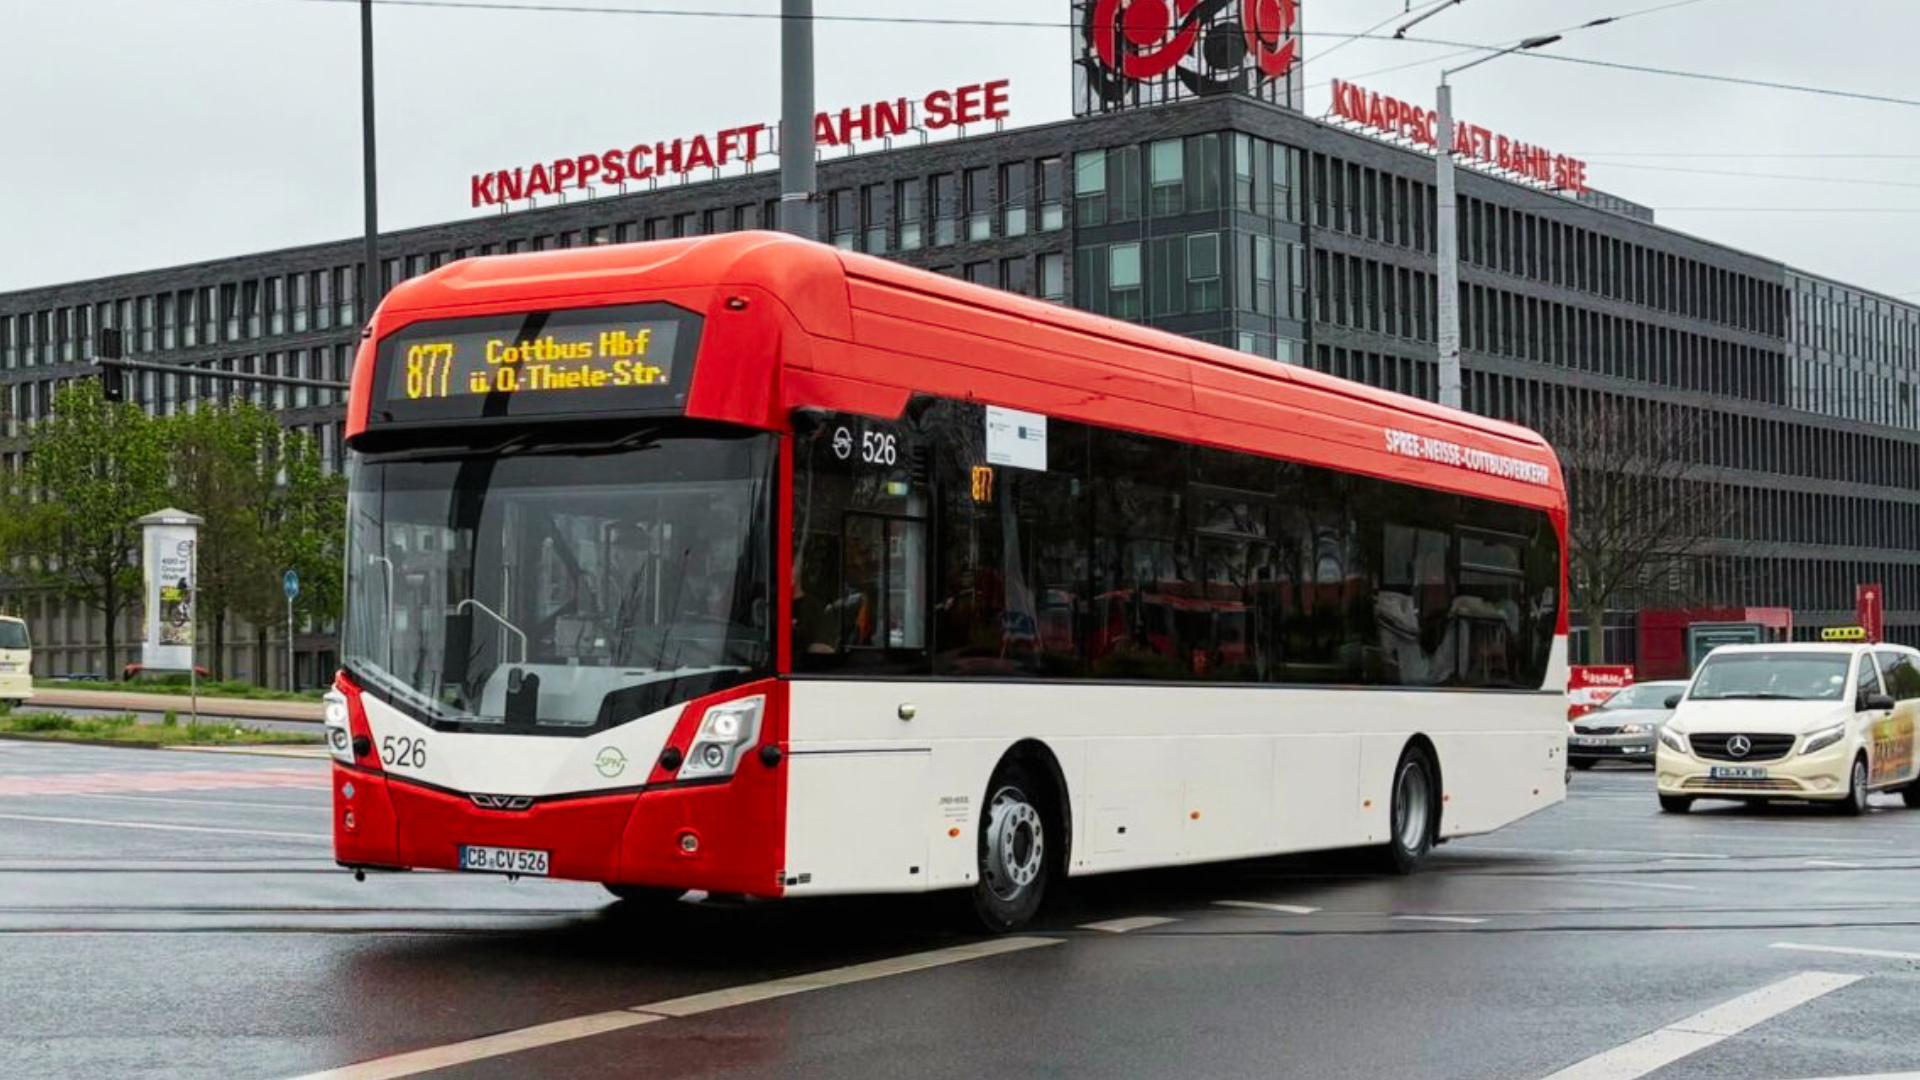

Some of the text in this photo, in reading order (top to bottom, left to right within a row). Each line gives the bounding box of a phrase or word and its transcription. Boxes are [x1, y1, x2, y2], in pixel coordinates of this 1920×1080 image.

[471, 79, 1009, 207] KNAPPSCHAFT AHN SEE
[1332, 78, 1588, 194] KNAPPSCAFT BAHN SEE
[486, 329, 650, 363] Cottbus Hbf
[406, 342, 453, 398] 877
[862, 431, 896, 465] 526
[972, 466, 992, 501] 877
[382, 735, 426, 768] 526
[468, 847, 546, 871] CB CV 526
